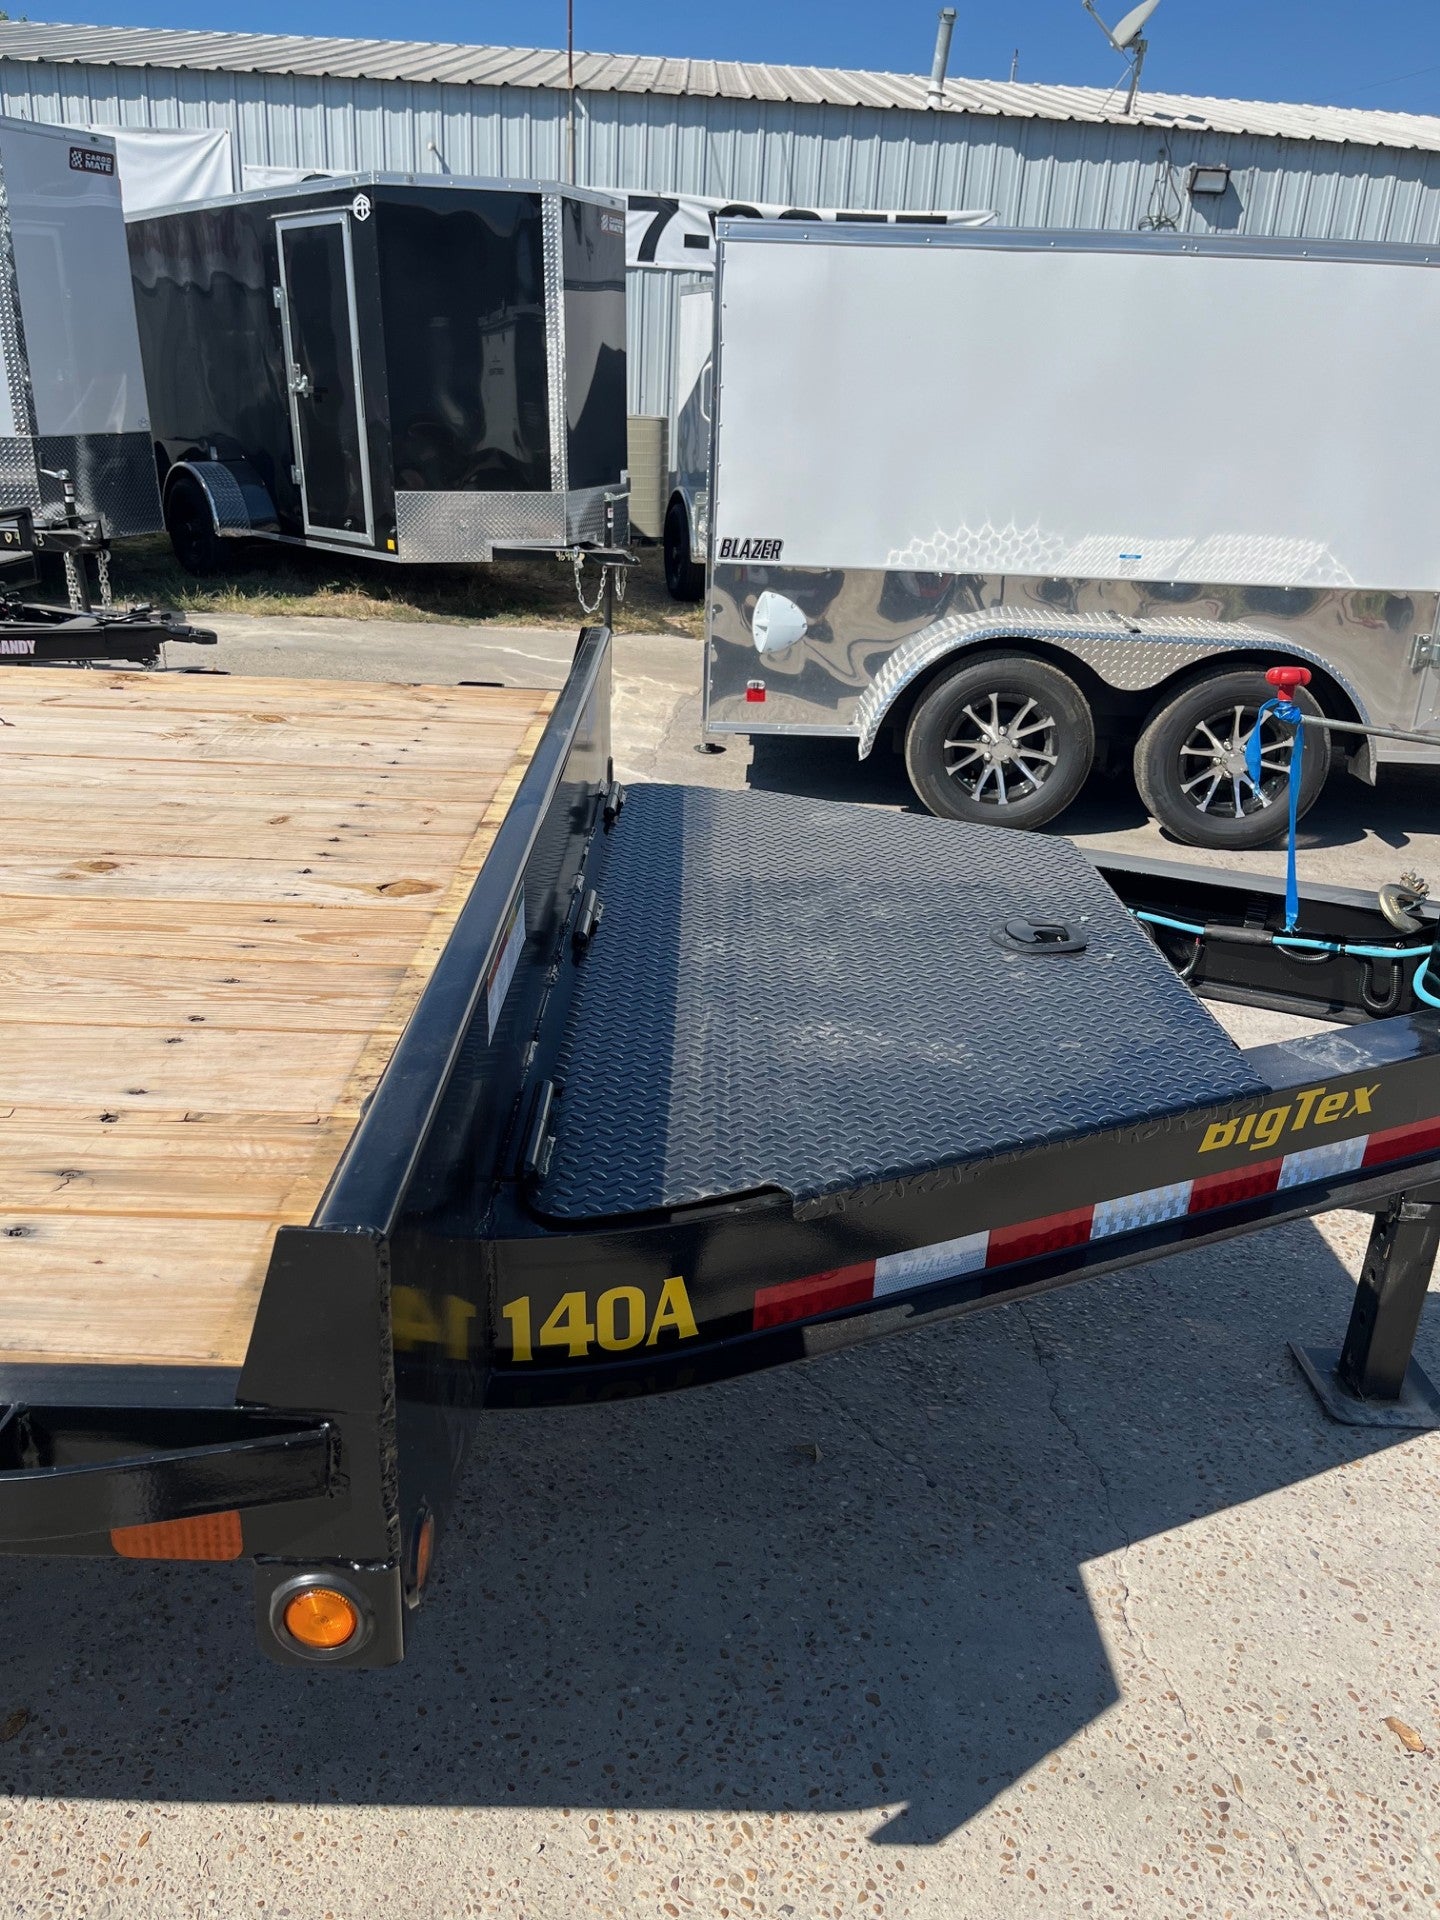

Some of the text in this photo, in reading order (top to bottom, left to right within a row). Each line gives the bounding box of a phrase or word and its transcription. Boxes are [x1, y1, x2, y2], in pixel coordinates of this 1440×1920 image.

[85, 153, 112, 164] CARGO
[85, 160, 112, 172] MATE
[719, 538, 784, 560] BLAZER
[0, 640, 36, 654] ANDY
[503, 1276, 700, 1361] 140A
